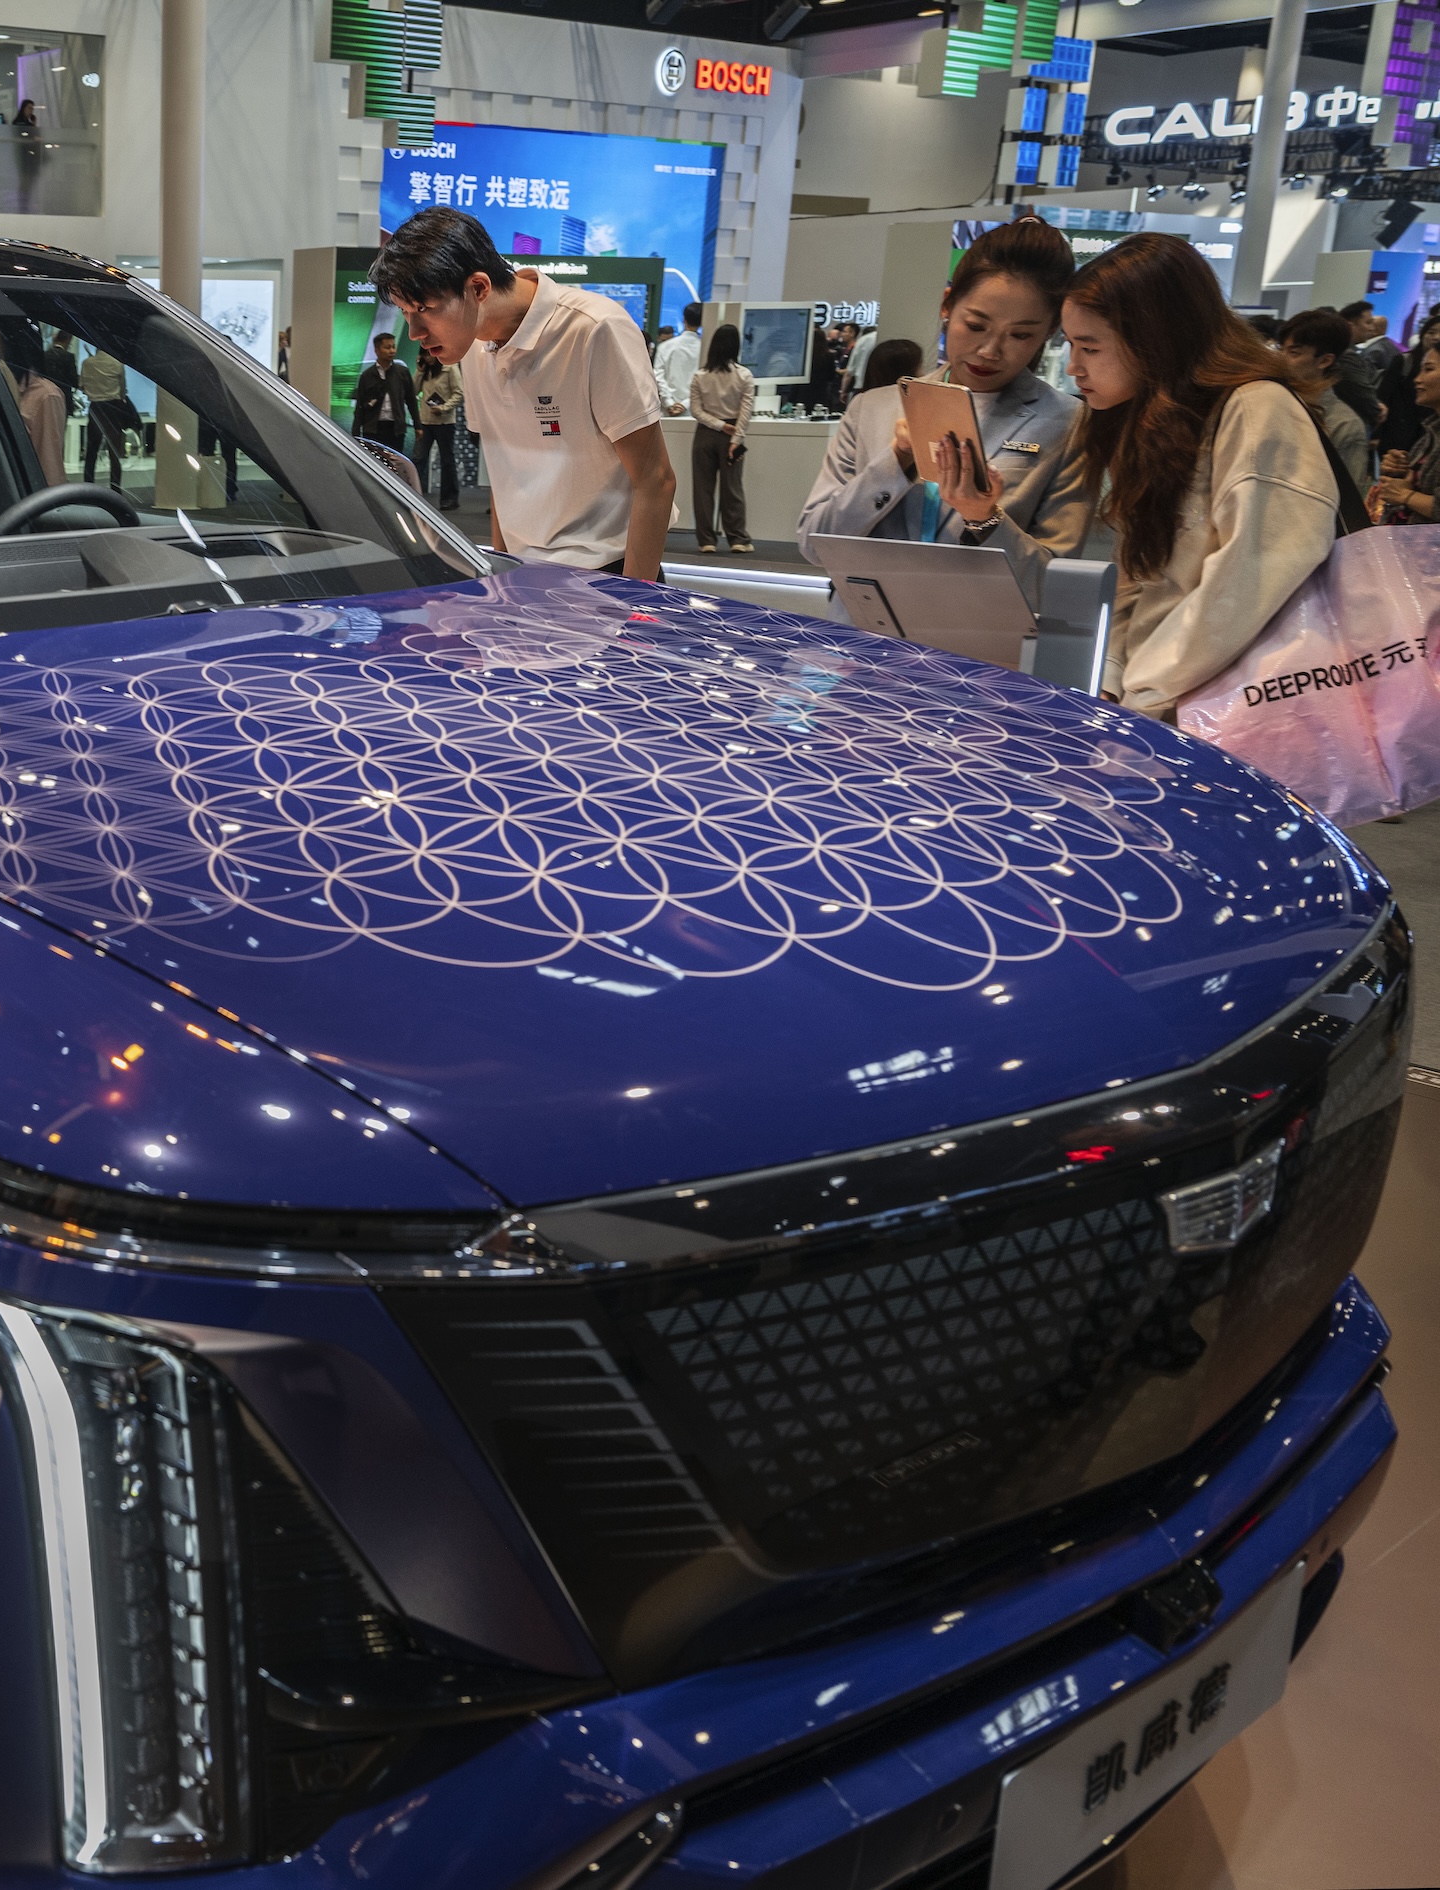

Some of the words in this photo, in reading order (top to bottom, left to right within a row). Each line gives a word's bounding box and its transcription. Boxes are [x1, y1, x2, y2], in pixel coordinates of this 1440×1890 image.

[696, 58, 772, 96] BOSCH
[408, 170, 478, 207] 擎智行
[484, 175, 570, 210] 共塑致远
[347, 295, 376, 304] comme
[832, 300, 881, 328] 中创
[1243, 652, 1380, 708] DEEPROUTE
[1083, 1661, 1231, 1815] 凯威德
